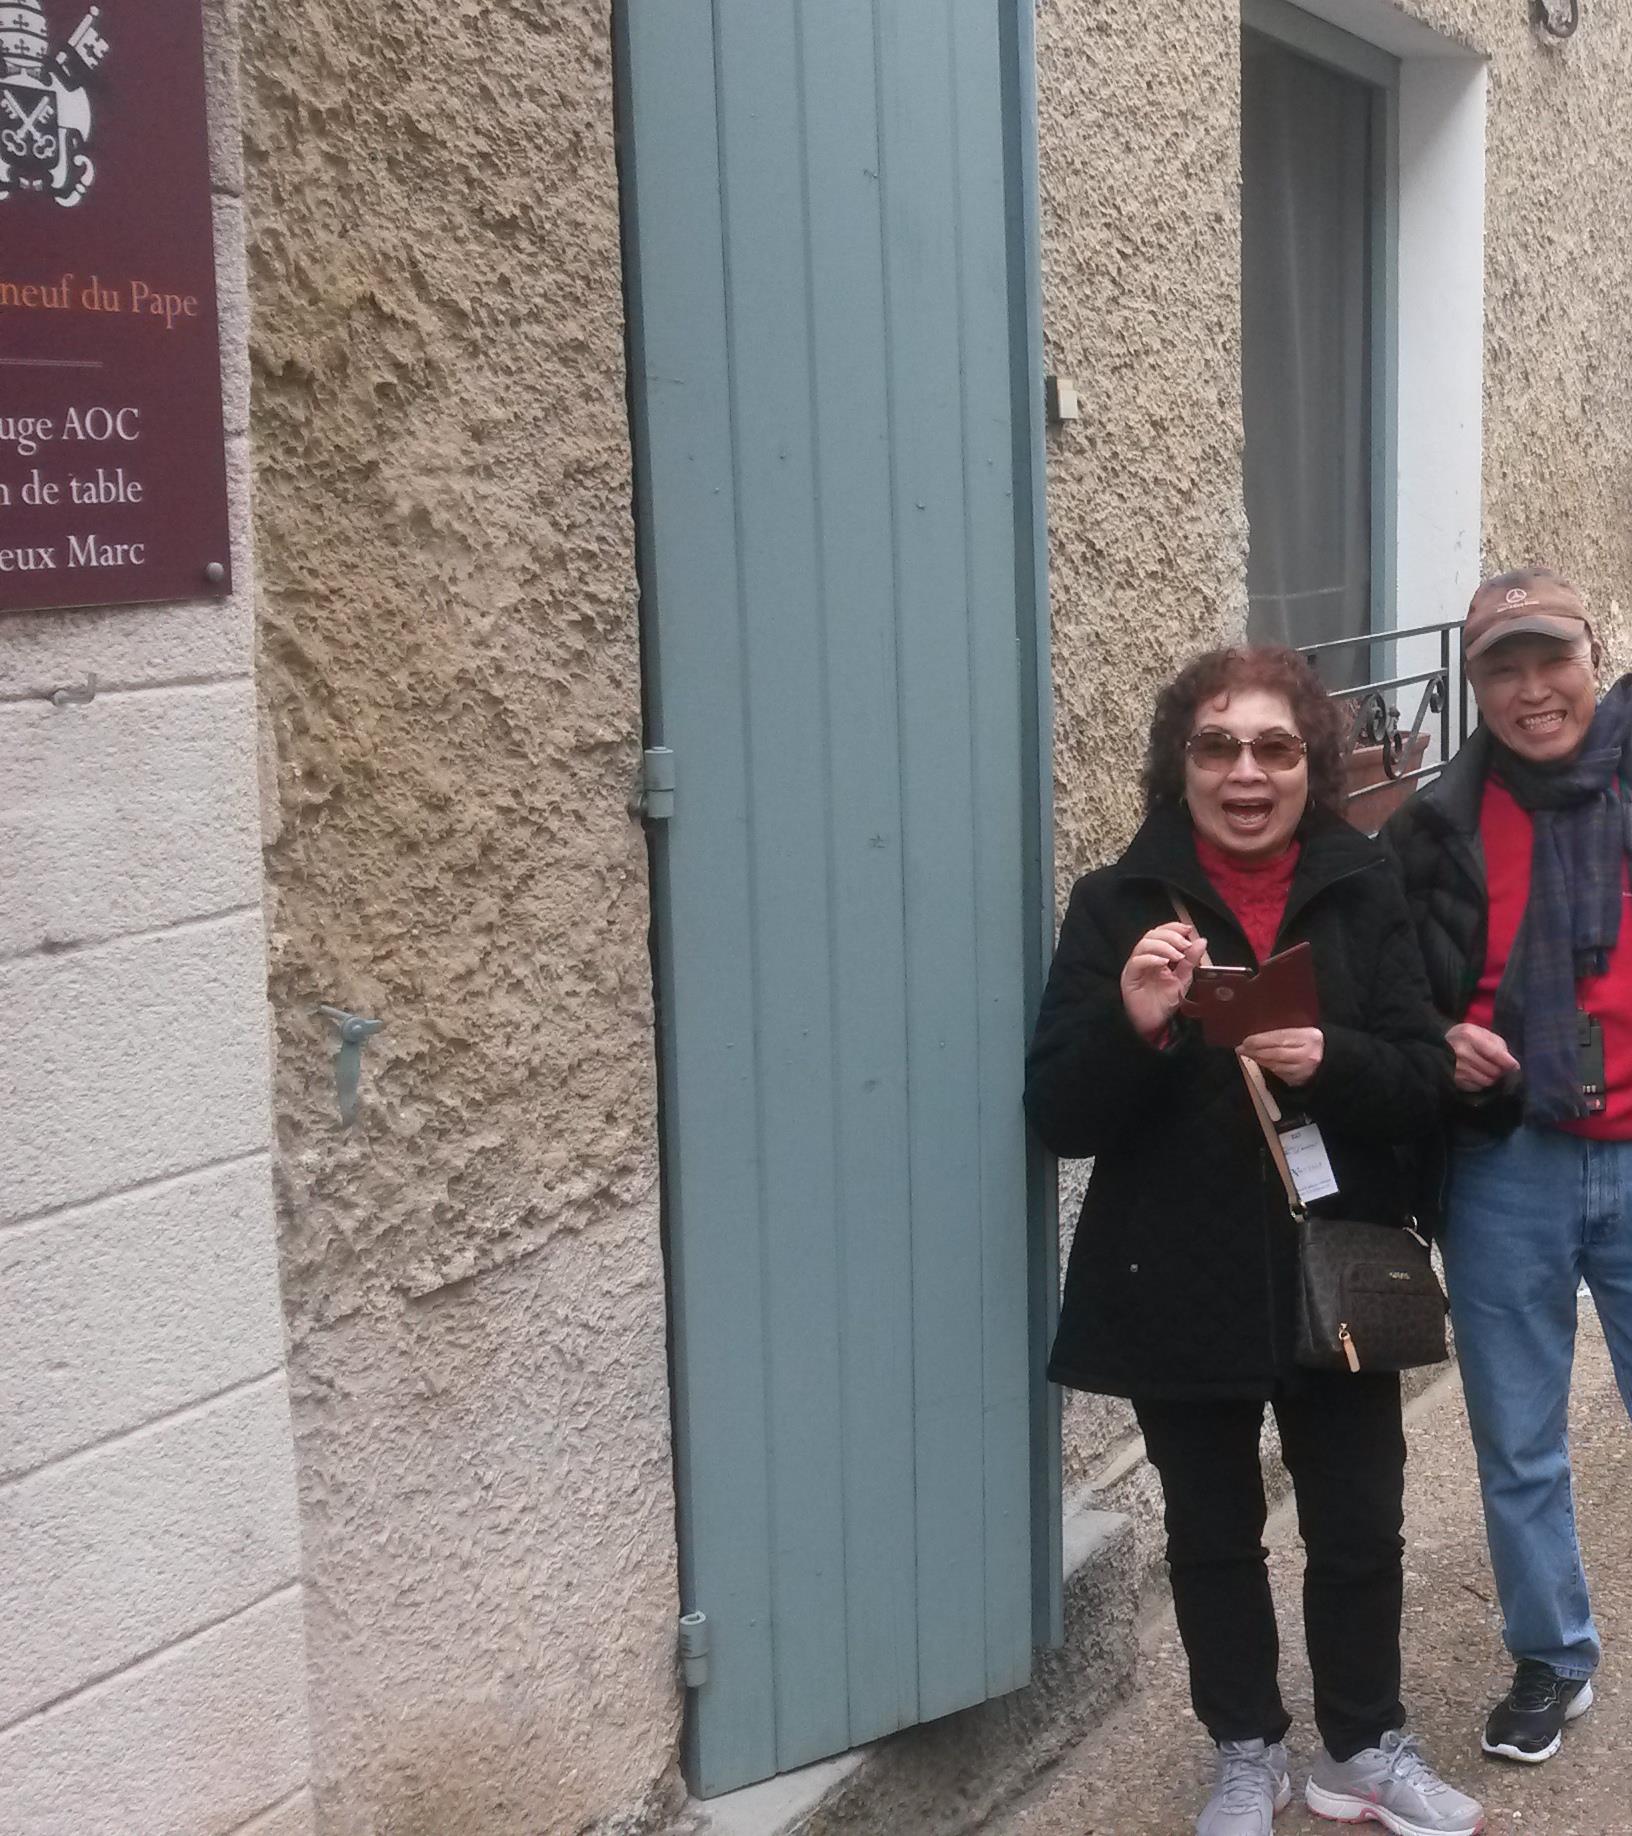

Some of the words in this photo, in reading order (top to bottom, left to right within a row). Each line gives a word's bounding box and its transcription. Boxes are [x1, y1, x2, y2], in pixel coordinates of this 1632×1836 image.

[0, 273, 73, 309] neuf
[81, 275, 121, 312] du
[131, 281, 199, 329] Pape
[0, 417, 53, 456] uge
[62, 407, 140, 440] AOC
[21, 468, 60, 505] de
[69, 467, 144, 505] table
[0, 547, 57, 572] eux
[66, 534, 146, 568] Marc
